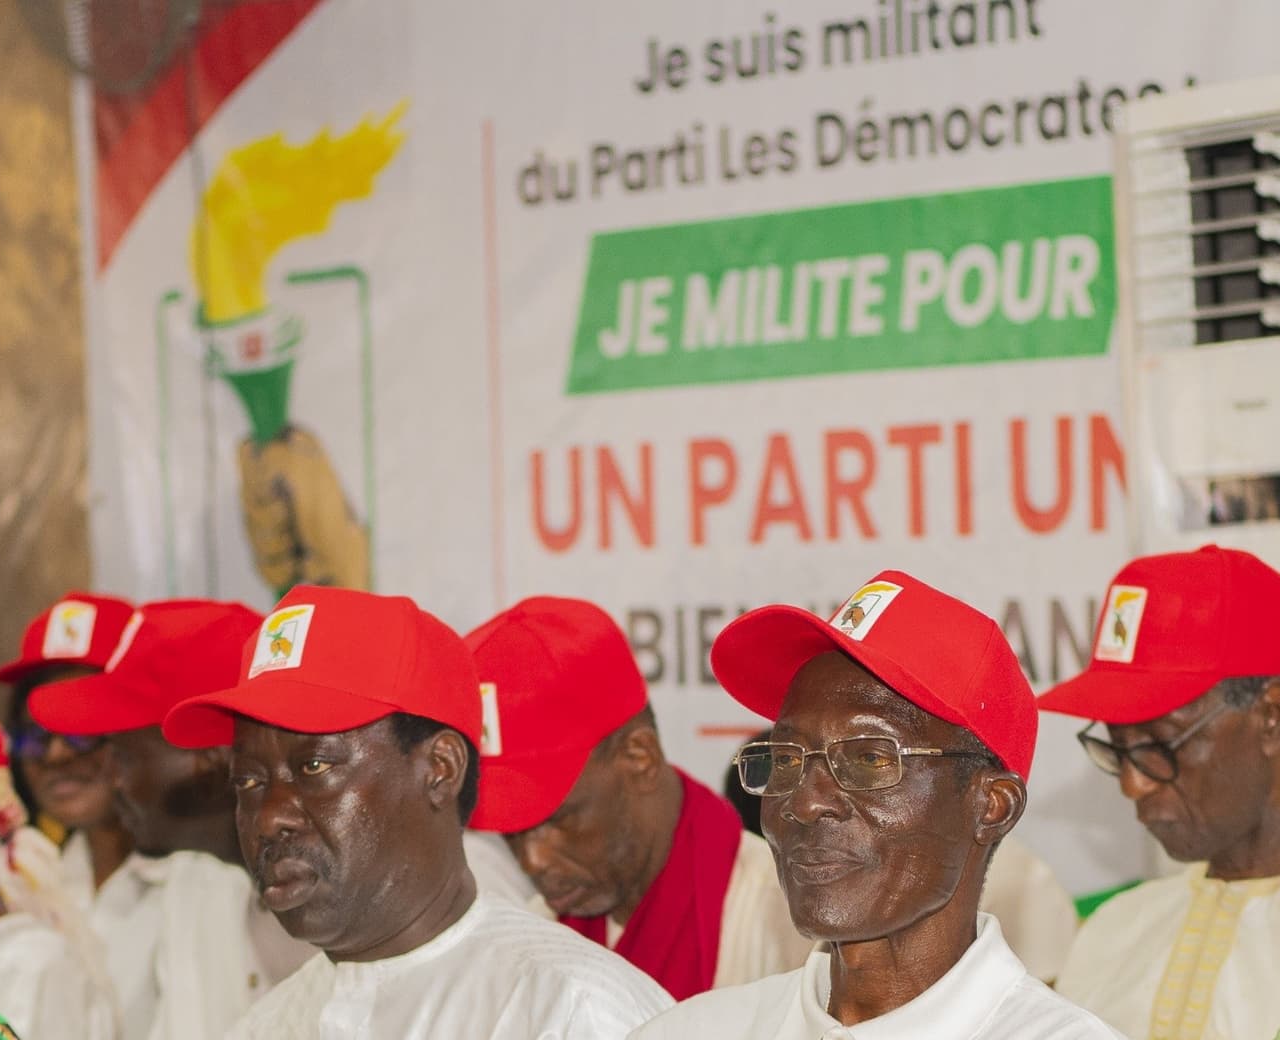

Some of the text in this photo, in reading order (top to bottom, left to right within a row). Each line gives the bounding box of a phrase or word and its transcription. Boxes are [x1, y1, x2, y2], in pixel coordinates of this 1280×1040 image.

[634, 0, 1041, 92] Je suis militant
[518, 150, 577, 206] du
[591, 120, 705, 197] Parti
[719, 125, 799, 181] Les
[597, 233, 1102, 359] JE MILITE POUR
[530, 440, 657, 554] UN
[686, 420, 974, 548] PARTI
